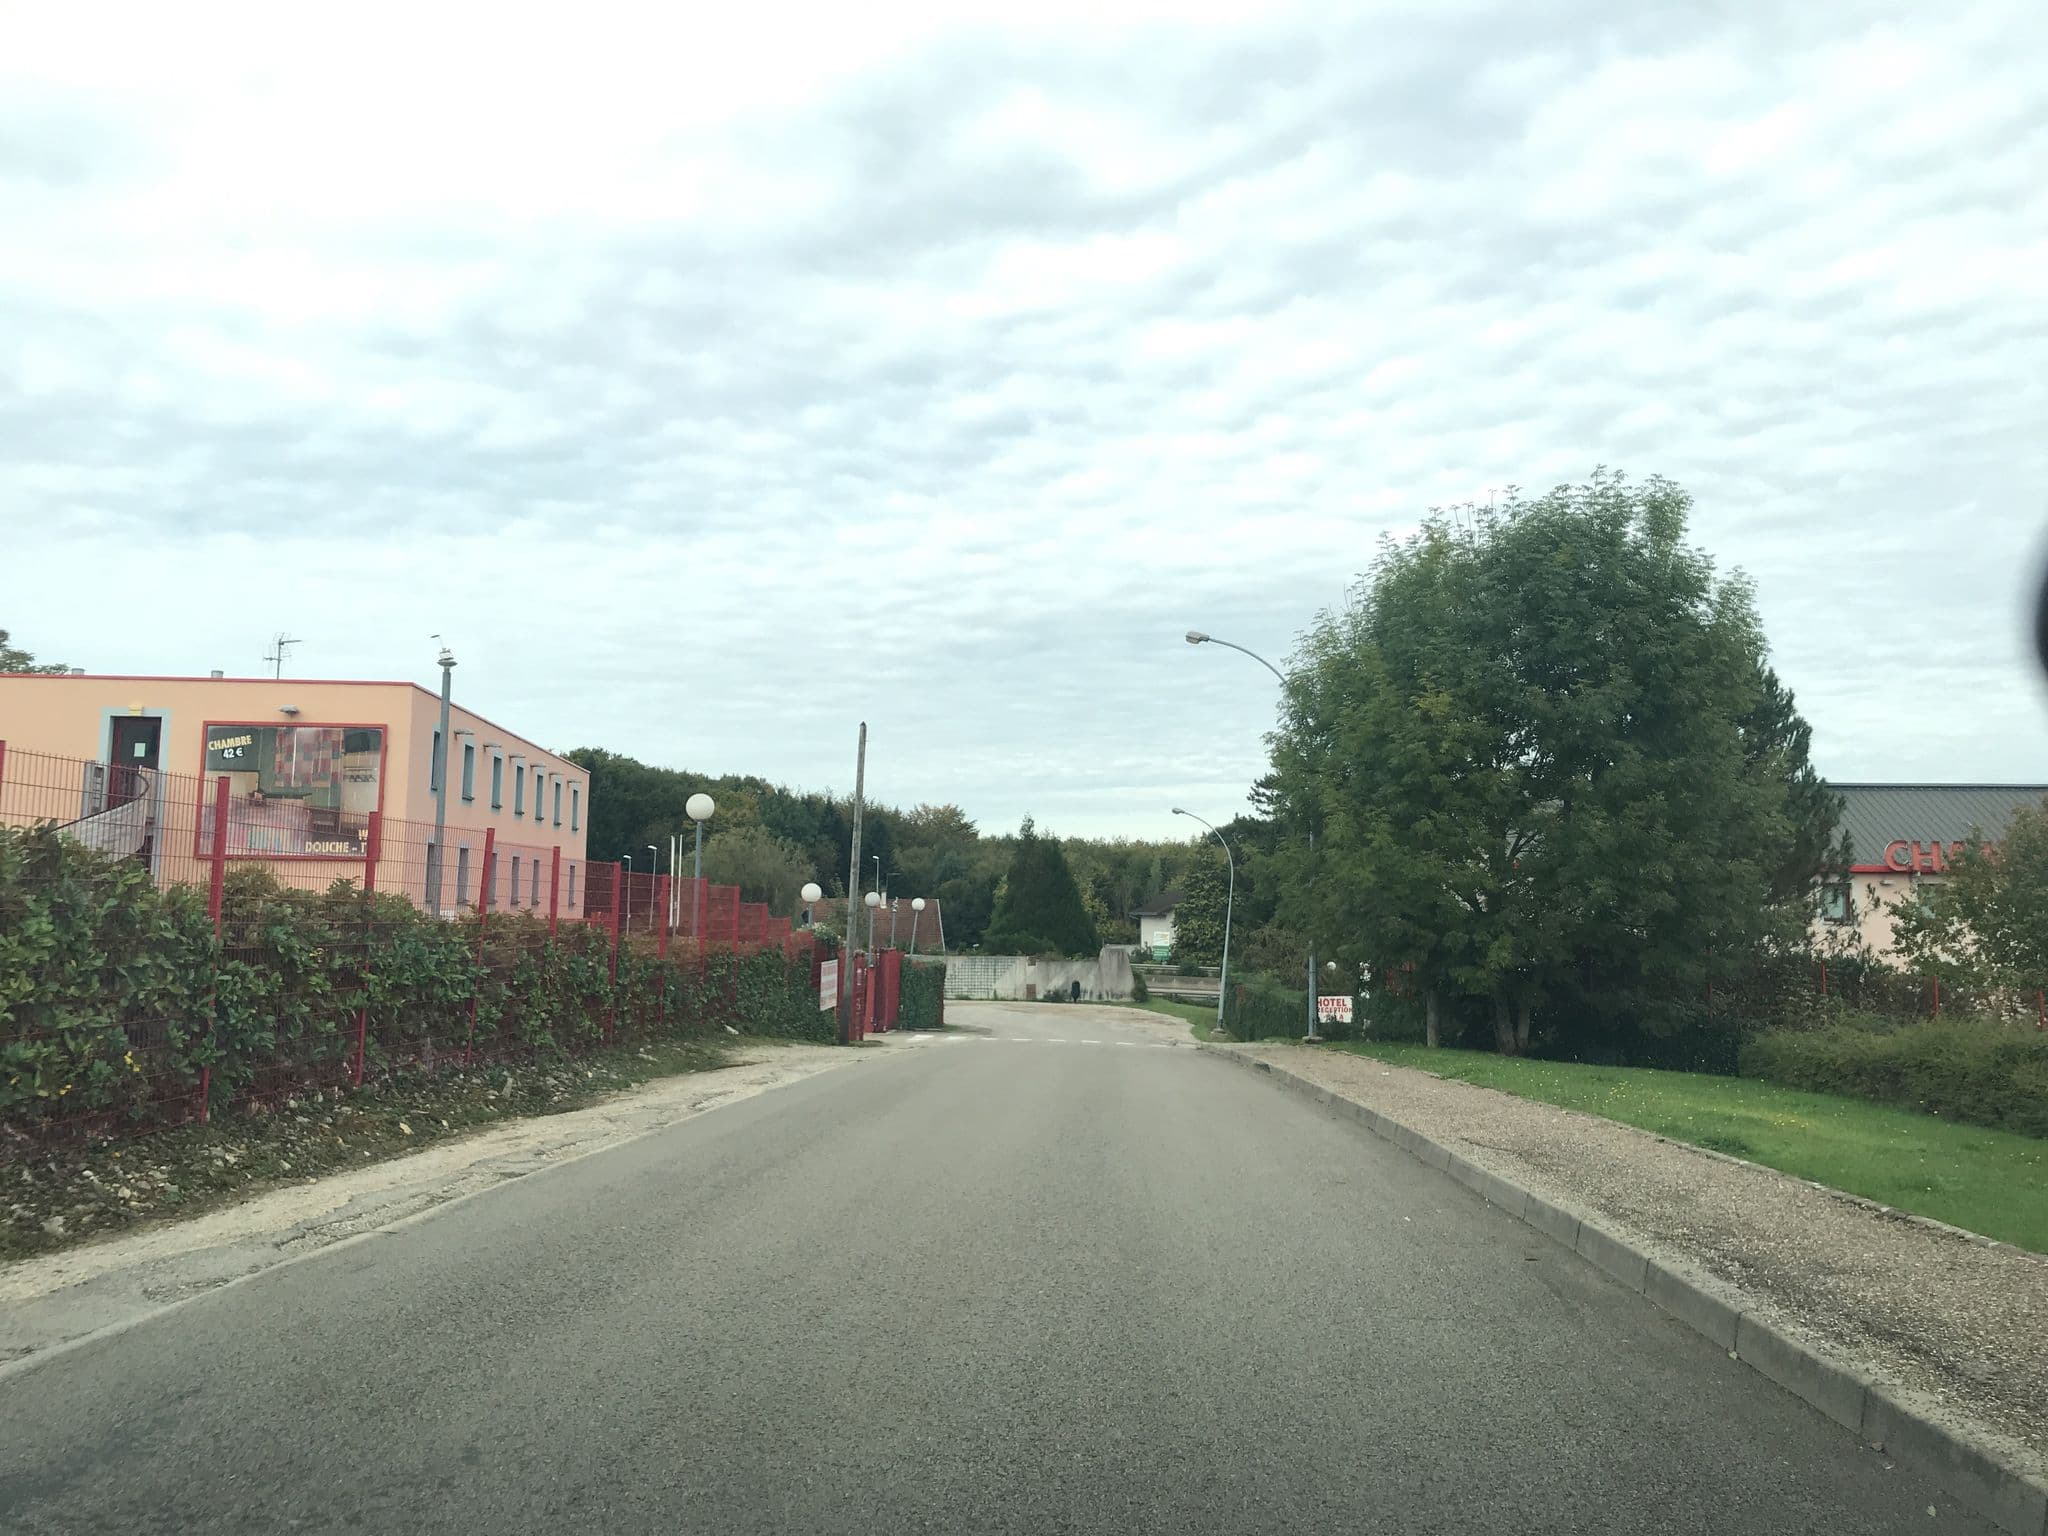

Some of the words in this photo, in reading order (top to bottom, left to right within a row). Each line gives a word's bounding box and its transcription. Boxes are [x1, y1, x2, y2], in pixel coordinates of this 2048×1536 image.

[208, 734, 252, 751] CHAMBRE
[222, 748, 235, 758] 42
[235, 747, 244, 757] €
[305, 841, 349, 853] DOUCHE
[1316, 998, 1347, 1007] HOTEL
